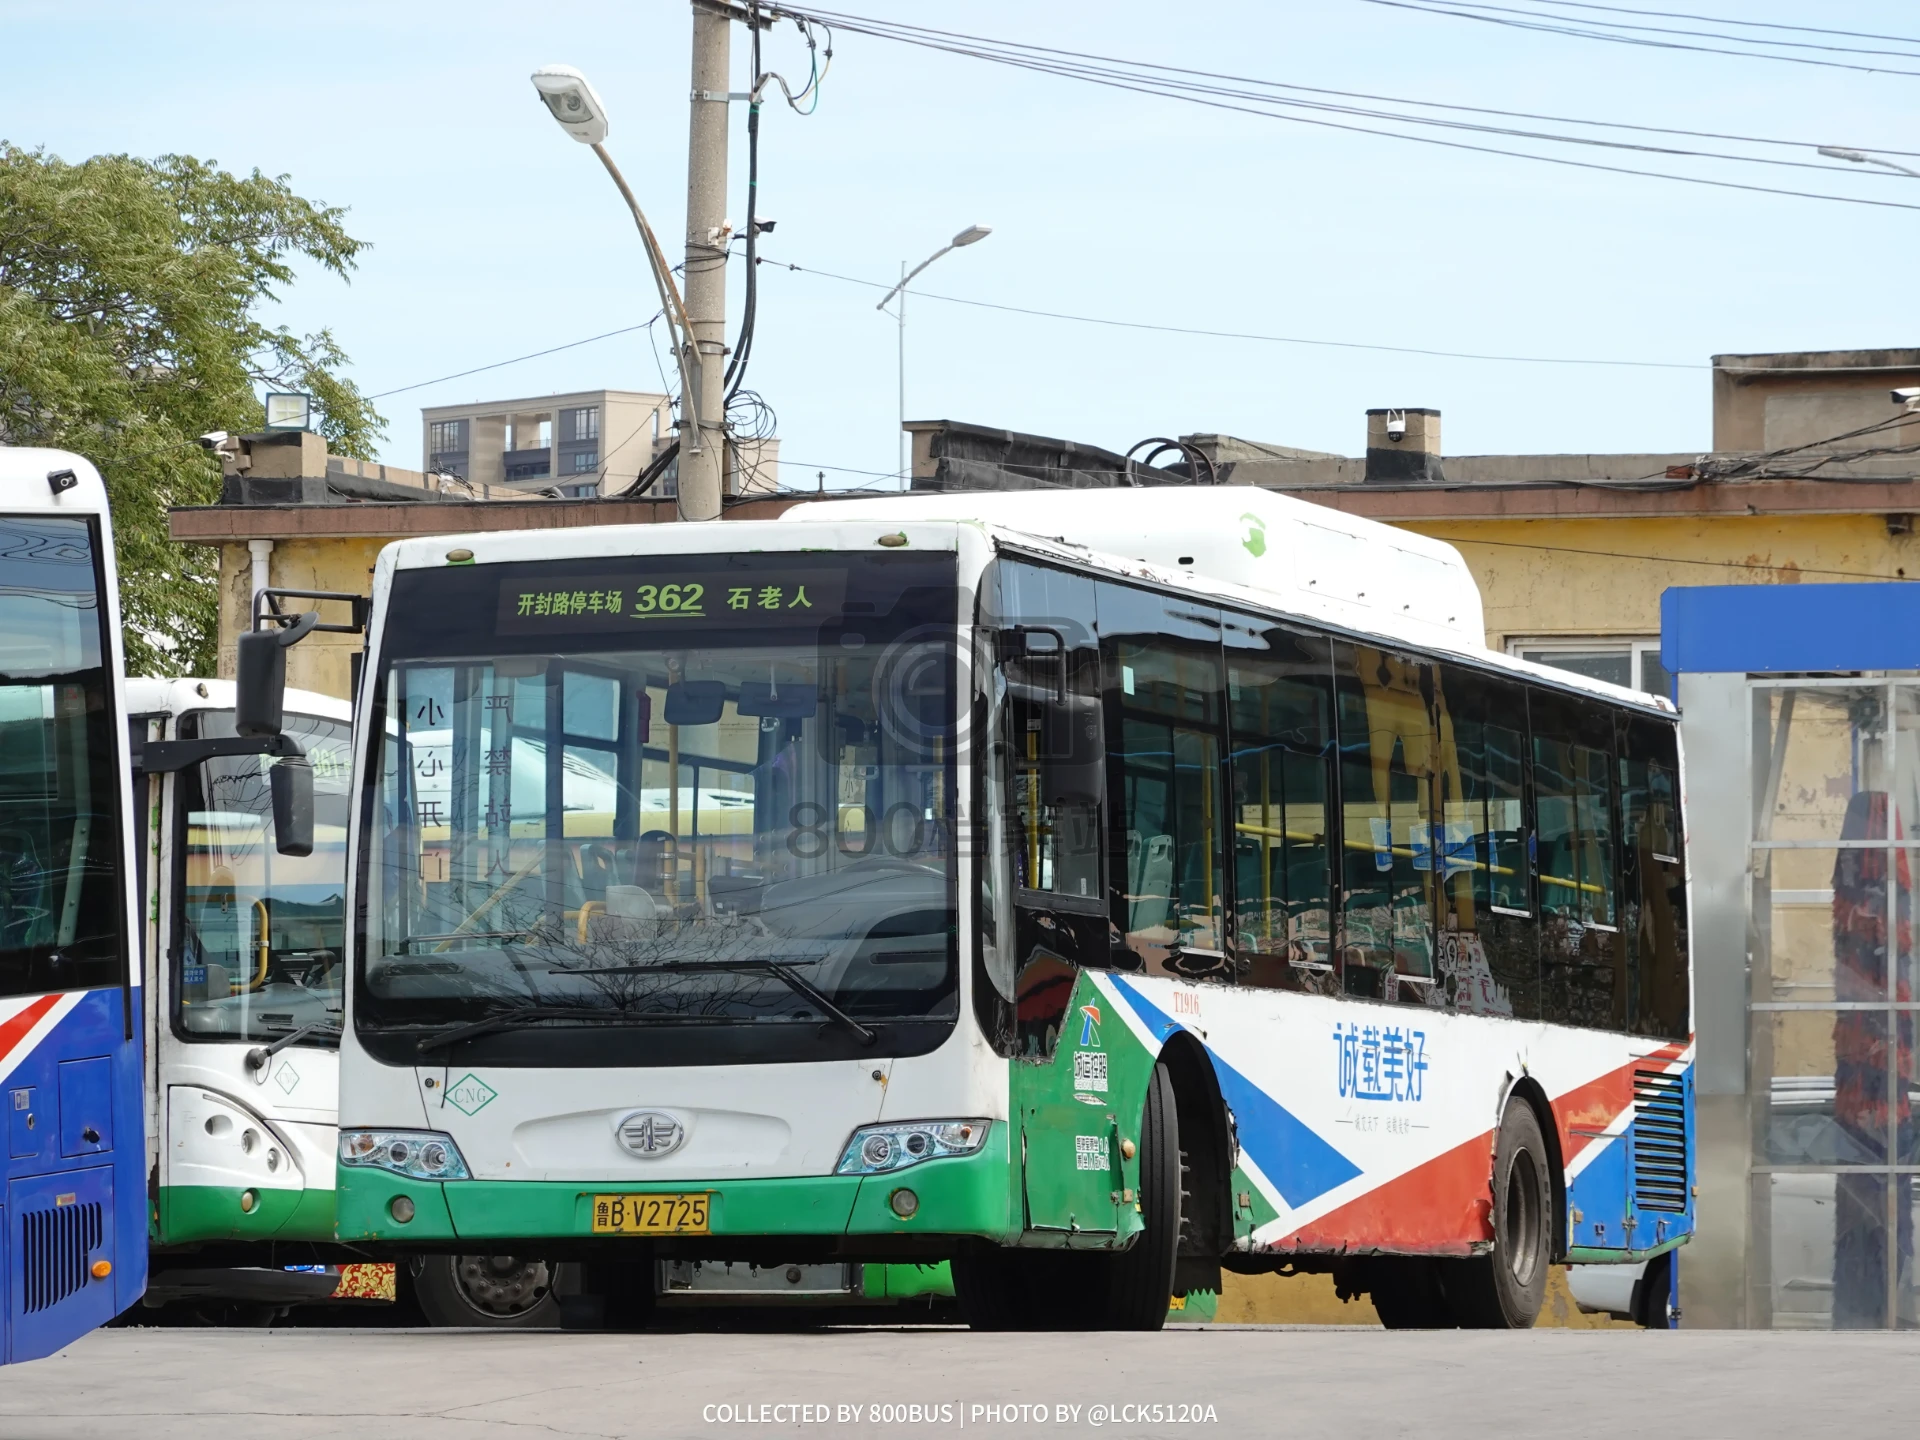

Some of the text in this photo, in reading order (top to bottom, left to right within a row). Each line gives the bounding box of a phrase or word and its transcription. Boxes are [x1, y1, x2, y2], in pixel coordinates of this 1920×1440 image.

[517, 583, 813, 616] 开封路停车场 362 石老人
[1174, 991, 1199, 1015] T1916
[1333, 1022, 1428, 1102] 诚载美好
[454, 1088, 486, 1103] CNG
